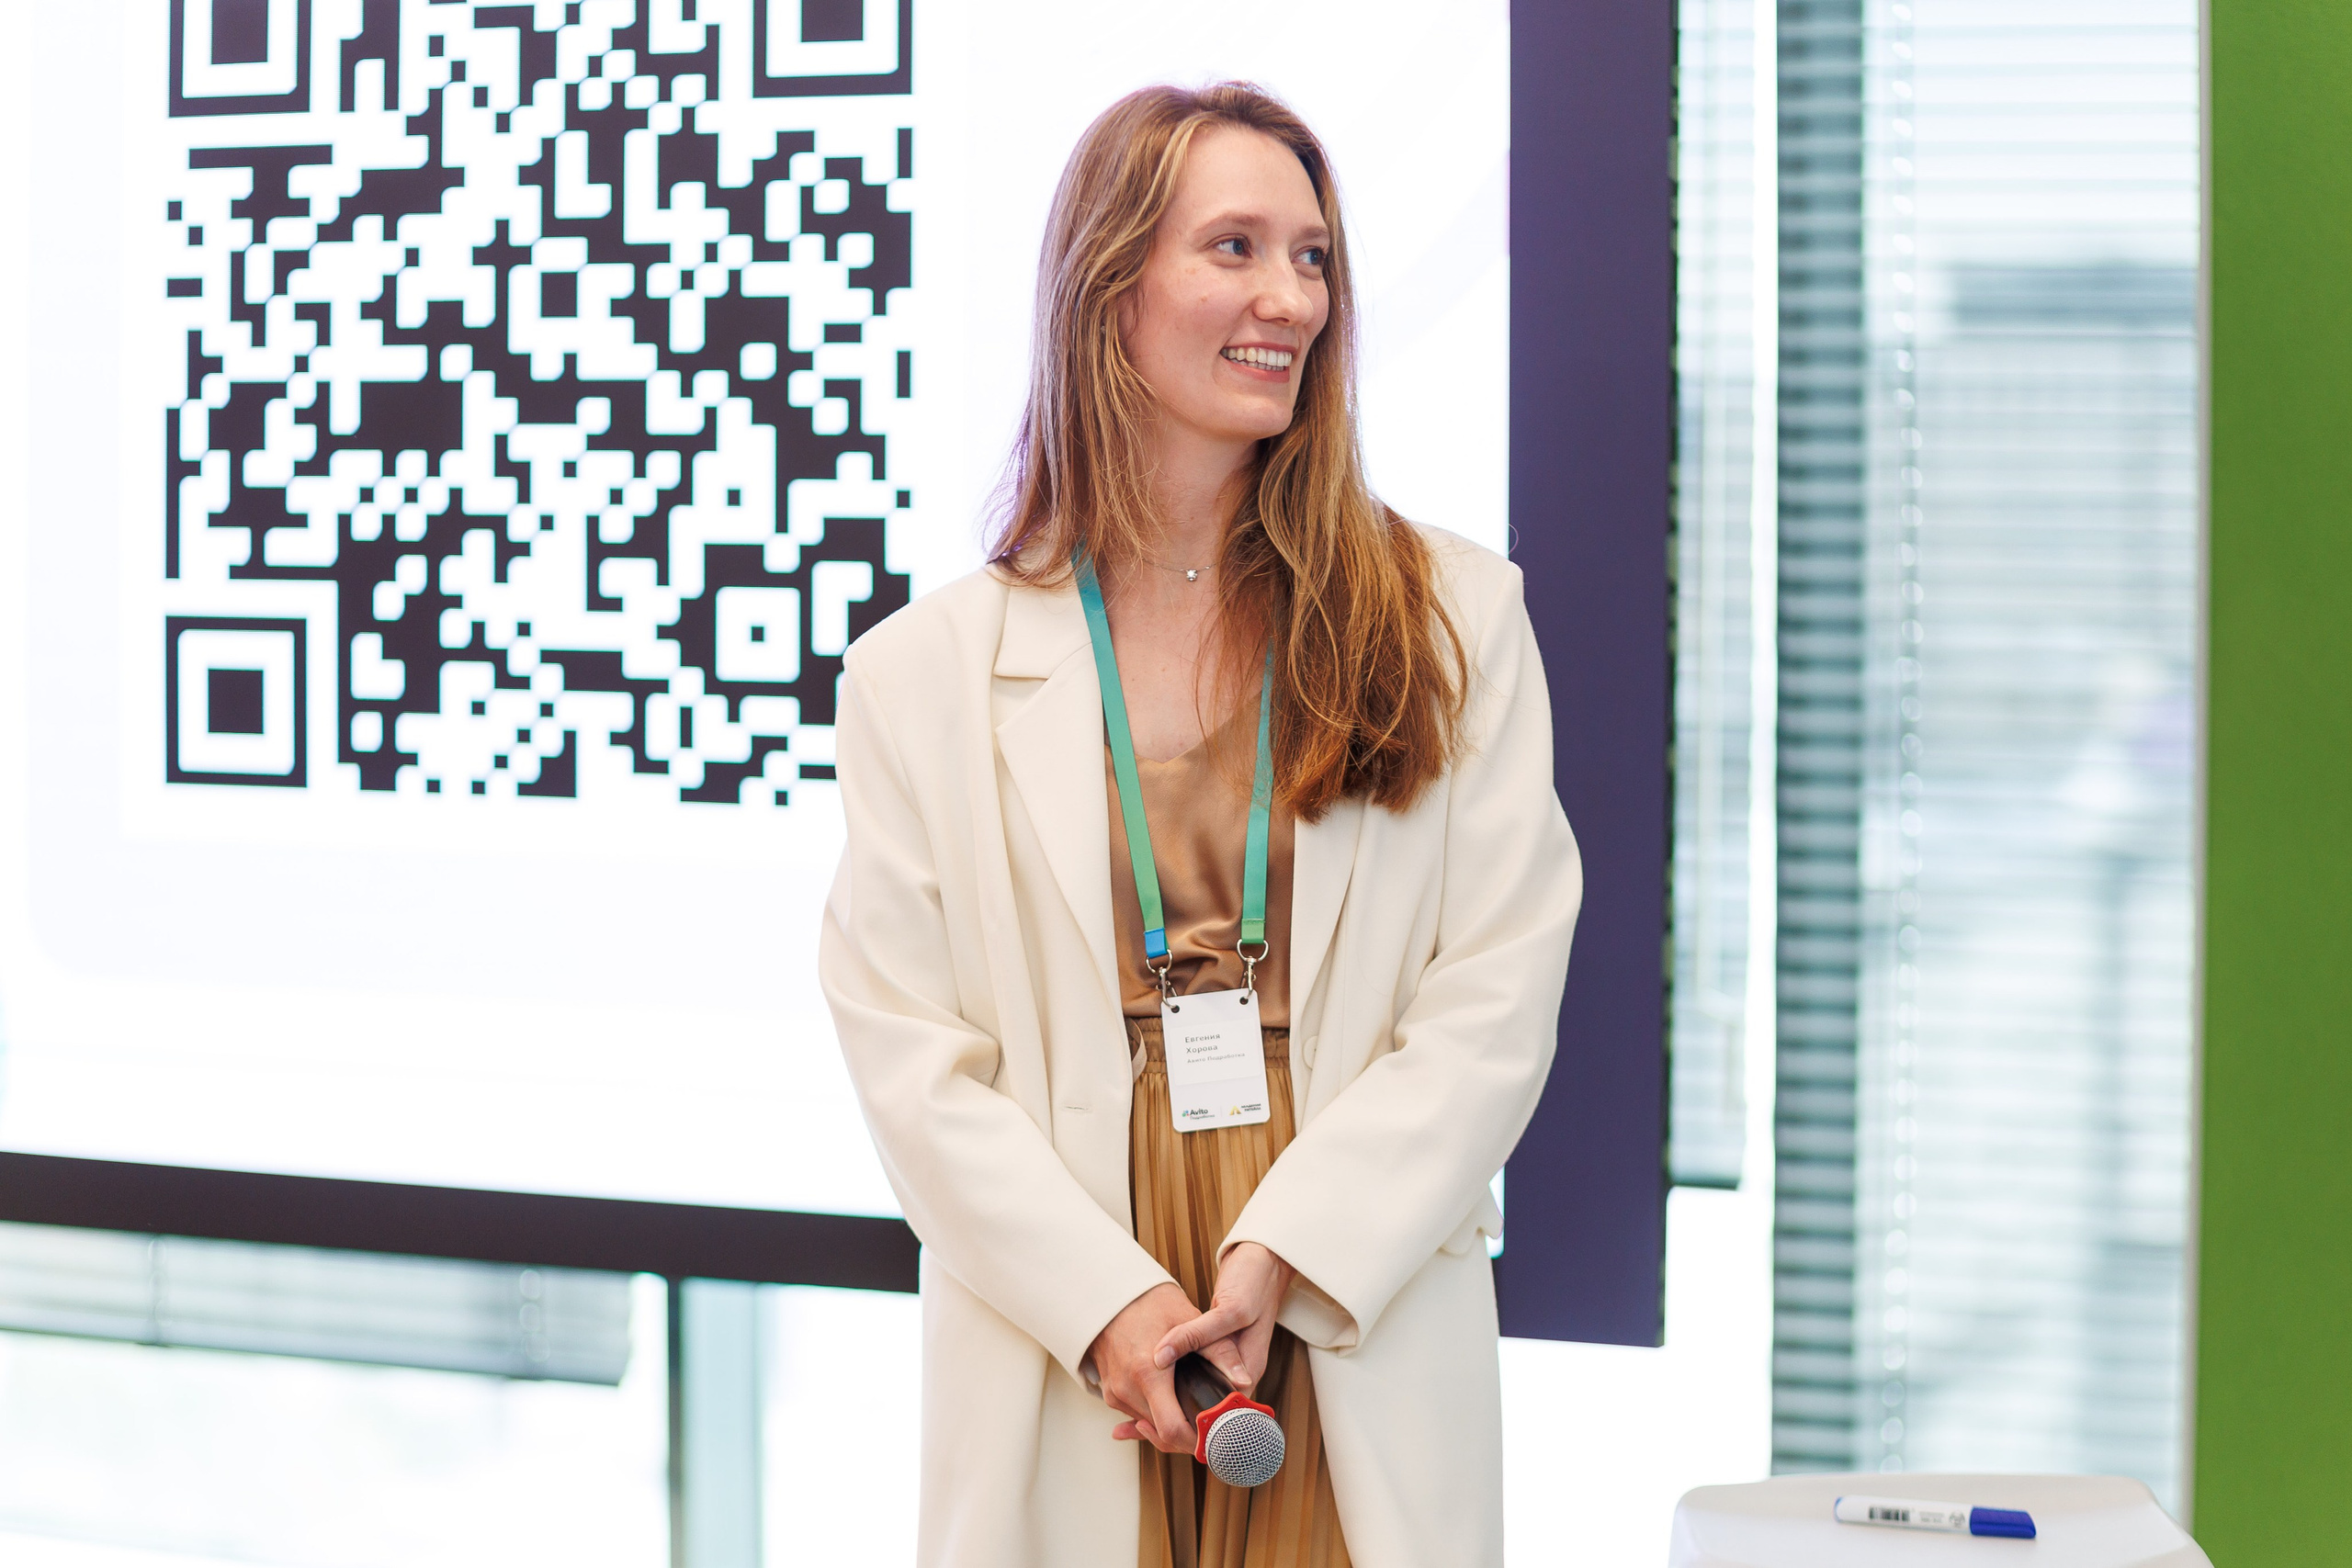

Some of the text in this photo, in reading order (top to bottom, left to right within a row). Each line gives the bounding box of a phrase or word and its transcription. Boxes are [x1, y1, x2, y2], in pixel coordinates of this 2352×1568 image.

[1184, 1033, 1221, 1043] Евгения
[1207, 1053, 1246, 1061] Подработка
[1190, 1108, 1209, 1116] Avito
